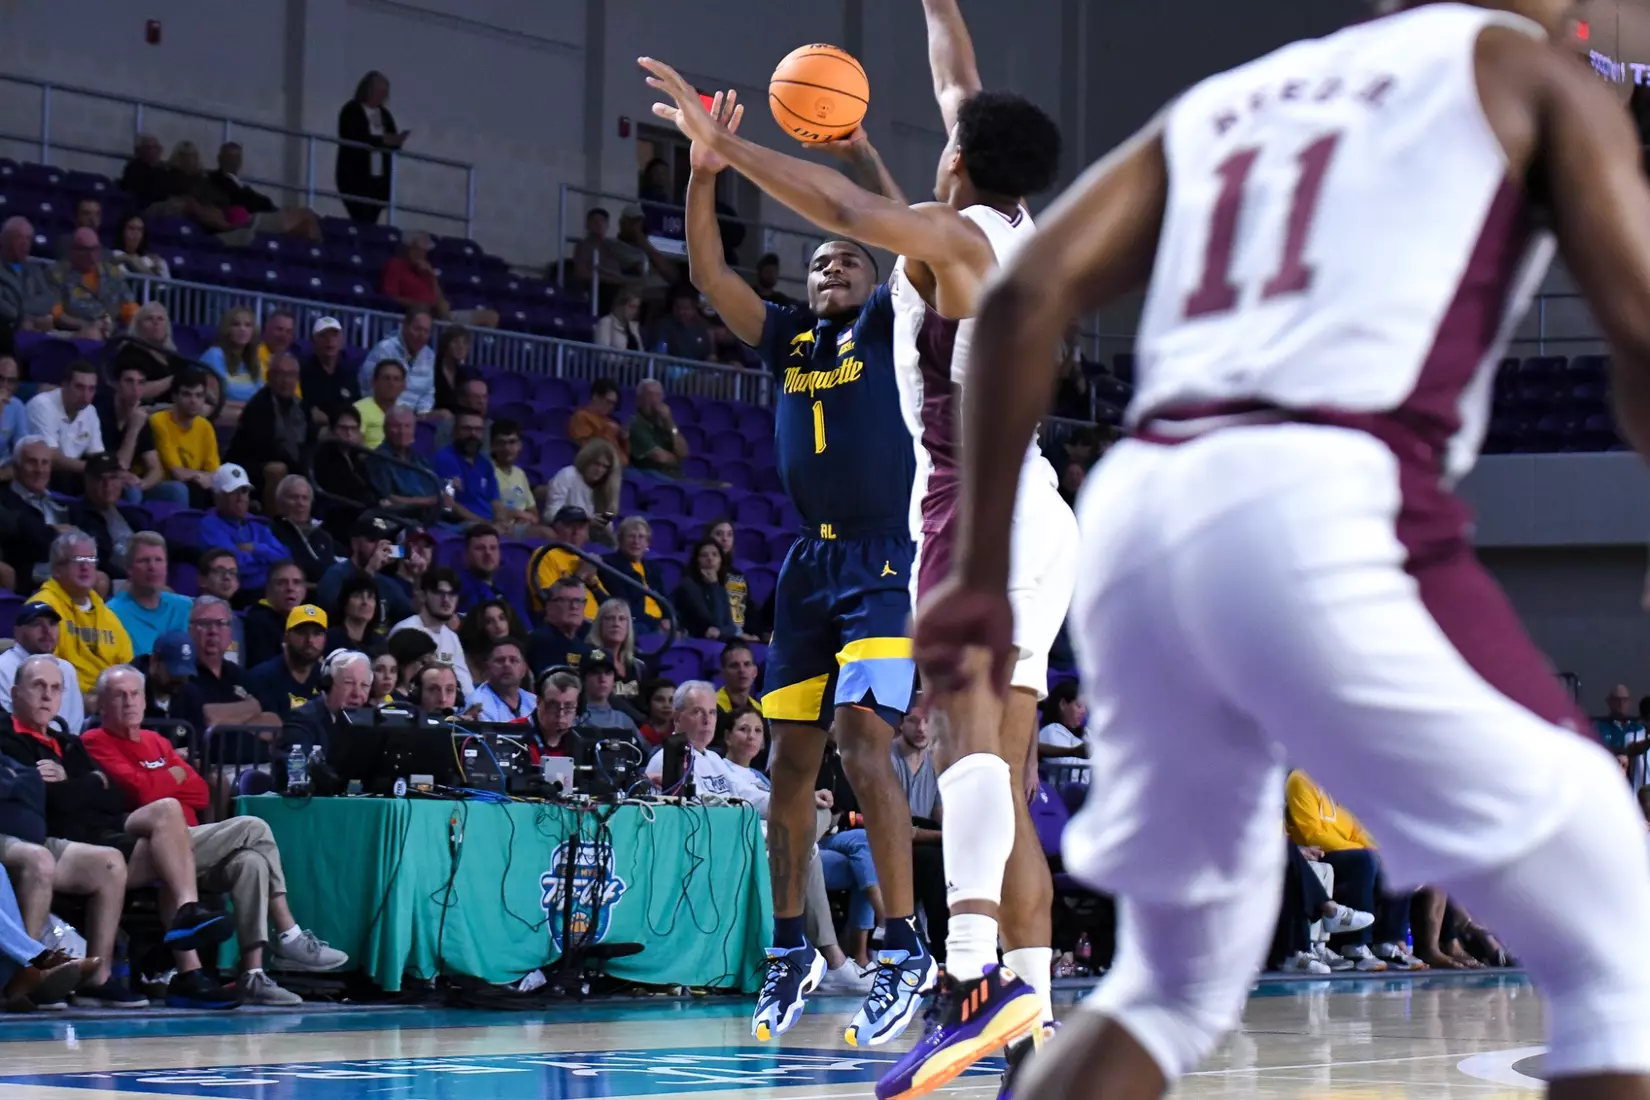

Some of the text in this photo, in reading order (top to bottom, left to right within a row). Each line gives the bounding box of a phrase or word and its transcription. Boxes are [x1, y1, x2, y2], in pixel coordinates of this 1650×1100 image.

[1183, 130, 1342, 320] 11
[784, 356, 863, 397] Marquette
[812, 400, 827, 453] 1
